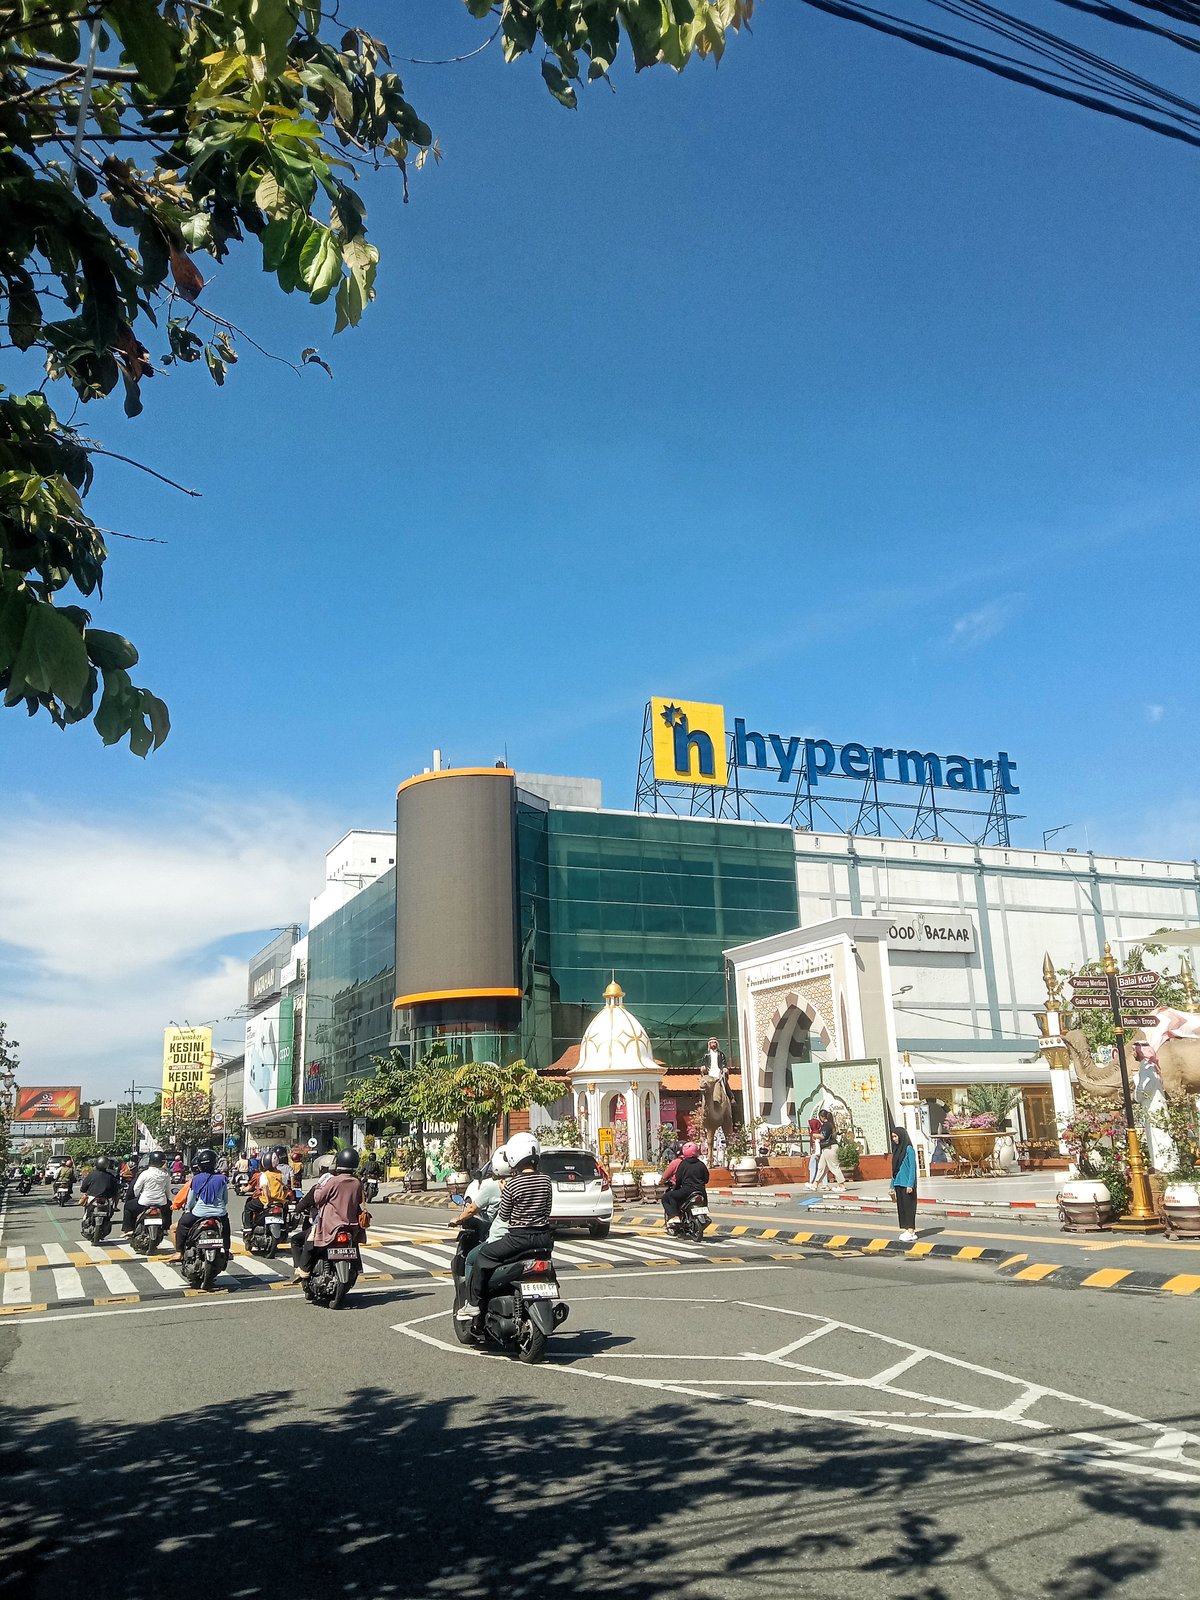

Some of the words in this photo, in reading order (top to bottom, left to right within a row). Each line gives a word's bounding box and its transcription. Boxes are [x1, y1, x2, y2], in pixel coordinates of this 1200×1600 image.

[734, 716, 1020, 795] hypermart
[887, 925, 915, 940] OOD
[924, 925, 970, 942] BAZAAR
[1073, 980, 1090, 988] Patung
[1090, 979, 1107, 987] Merlion
[1119, 976, 1137, 986] Balai
[1137, 974, 1155, 983] Kota
[1093, 998, 1109, 1006] Negara
[1121, 998, 1154, 1007] Ka'bah
[1141, 1018, 1156, 1026] Eropa
[169, 1042, 204, 1053] KESINI
[173, 1053, 200, 1063] DULU
[168, 1071, 203, 1082] KESINI
[173, 1082, 197, 1093] LAGI
